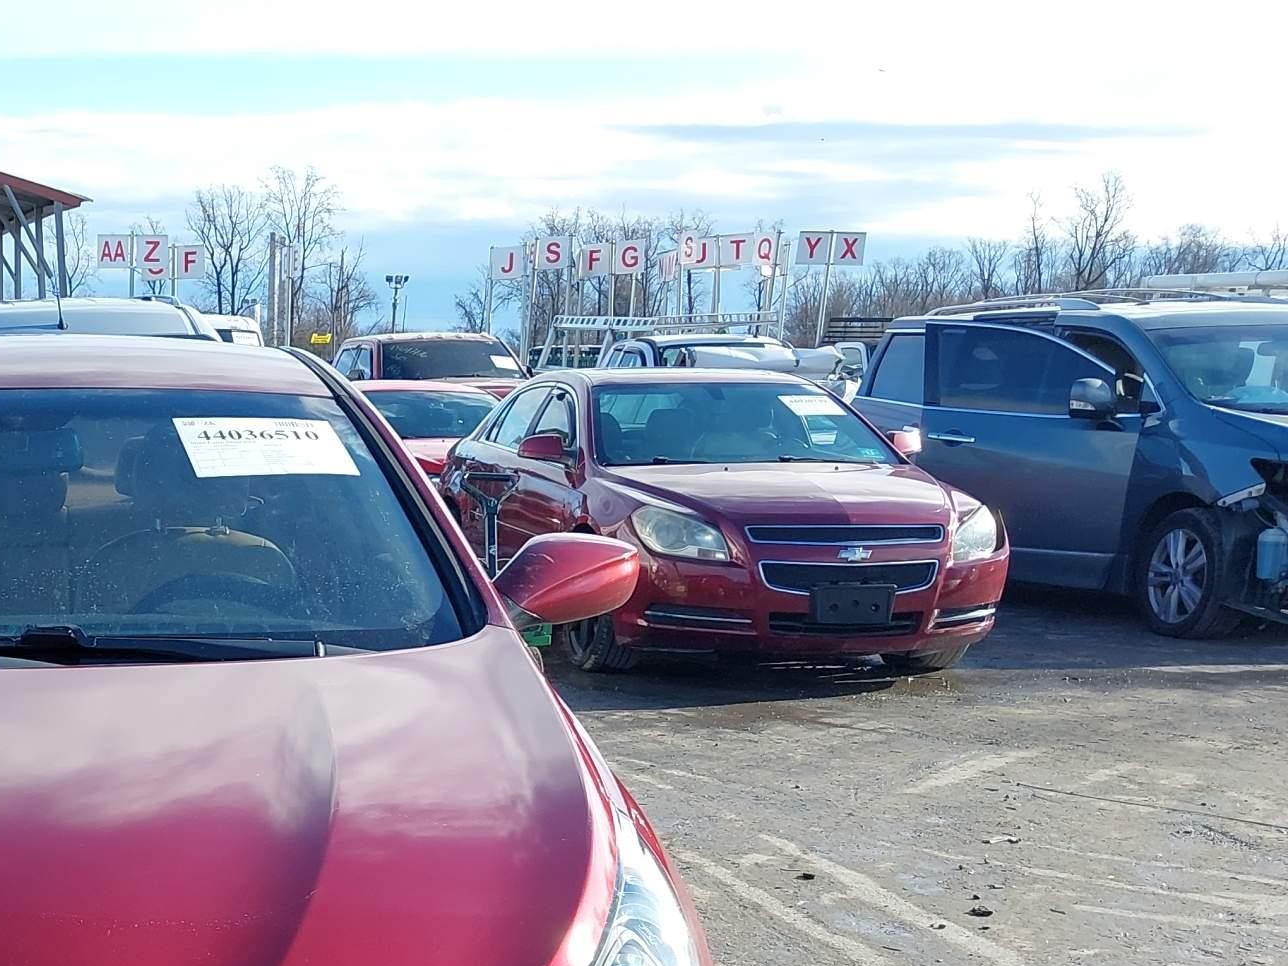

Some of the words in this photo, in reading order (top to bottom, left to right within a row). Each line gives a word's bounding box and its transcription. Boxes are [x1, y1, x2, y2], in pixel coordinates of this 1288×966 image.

[100, 240, 126, 262] AA
[143, 240, 161, 263] Z
[545, 242, 561, 264] S
[621, 246, 639, 268] G
[684, 236, 693, 258] S
[729, 239, 746, 260] T
[757, 238, 772, 261] Q
[805, 236, 823, 259] Y
[839, 237, 859, 260] X
[184, 251, 197, 273] F
[501, 252, 514, 274] J
[588, 249, 602, 271] F
[197, 430, 319, 441] 44036510
